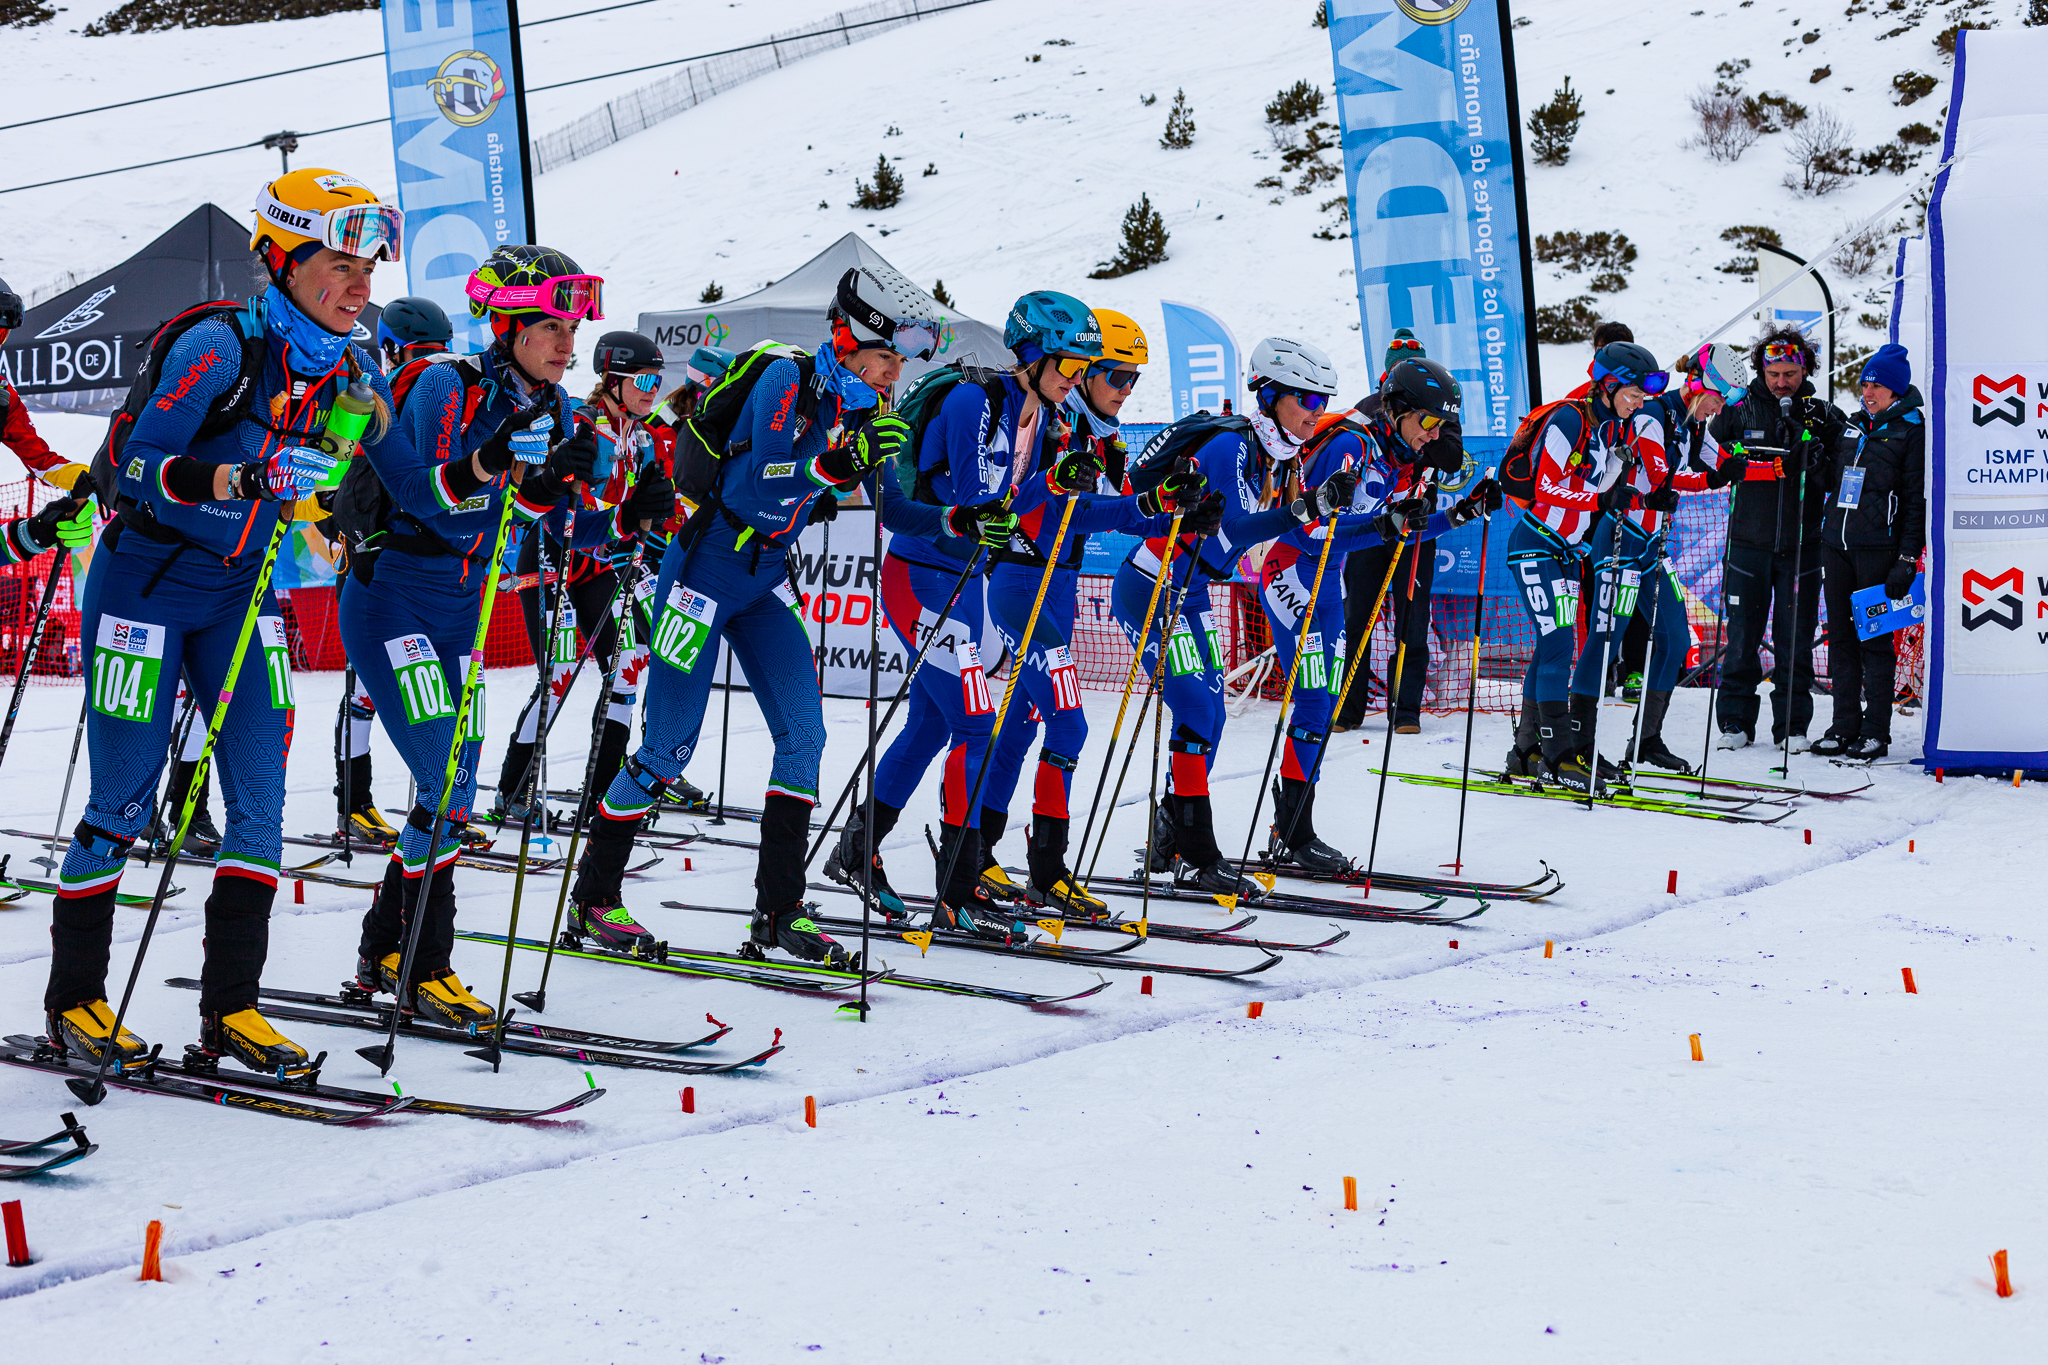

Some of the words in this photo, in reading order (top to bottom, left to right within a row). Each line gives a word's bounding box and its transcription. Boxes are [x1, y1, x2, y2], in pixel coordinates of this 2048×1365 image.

[279, 210, 312, 231] BLIZ
[505, 250, 537, 276] CAMP
[471, 284, 539, 303] SALICE
[1012, 308, 1033, 333] VISEO
[654, 324, 702, 347] MSO
[228, 376, 251, 408] CAMP
[849, 446, 865, 470] LEKI
[1985, 449, 2035, 465] ISMF
[764, 464, 795, 477] FORST
[199, 503, 243, 520] SUUNTO
[757, 510, 788, 522] SUUNTO
[1959, 515, 1985, 526] SKI
[1994, 513, 2048, 526] MOUN
[1014, 531, 1035, 557] CAMP
[1520, 560, 1558, 637] USA
[653, 608, 699, 671] 102.2
[814, 645, 910, 675] RKWEA
[94, 652, 154, 719] 104.1
[973, 917, 1011, 934] SCARPA
[417, 985, 428, 998] LA
[427, 991, 463, 1025] SPORTIVA
[61, 1018, 71, 1029] LA
[69, 1024, 103, 1059] SPORTIVA
[229, 1030, 267, 1064] SPORTIVA
[228, 1094, 254, 1105] LA
